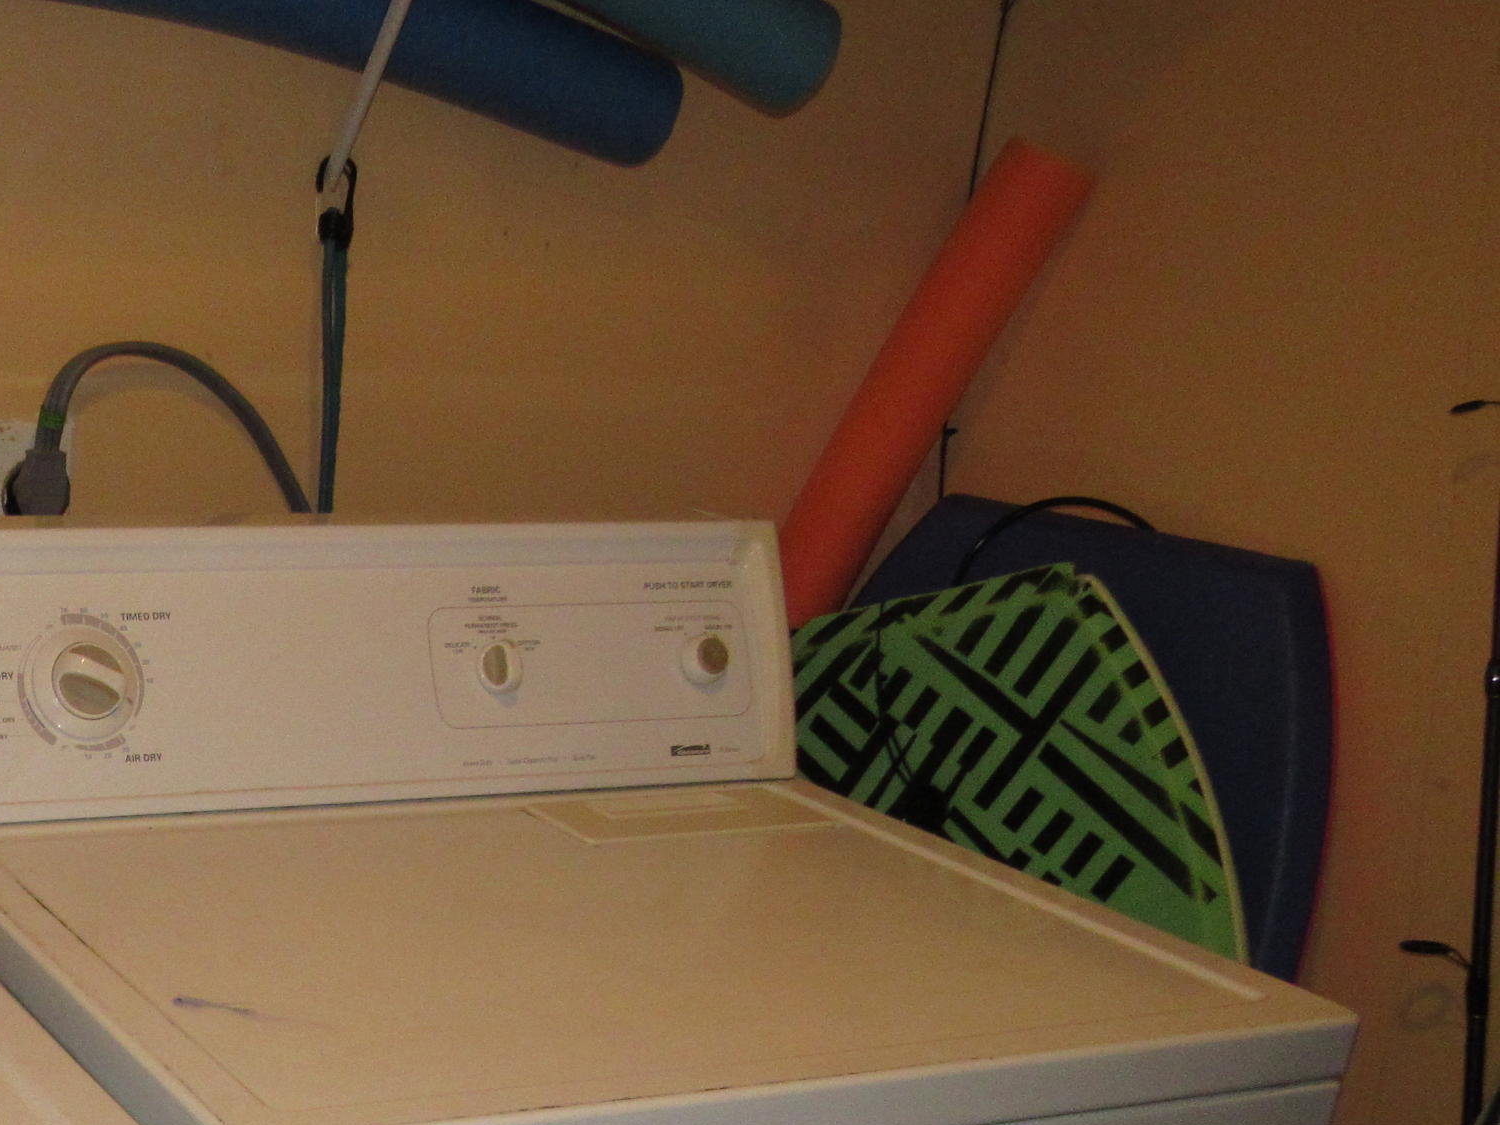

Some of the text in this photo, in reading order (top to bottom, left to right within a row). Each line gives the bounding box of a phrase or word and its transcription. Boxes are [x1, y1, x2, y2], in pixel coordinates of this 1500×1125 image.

[121, 611, 171, 621] TIMED DRY
[125, 753, 163, 763] AIR DRY
